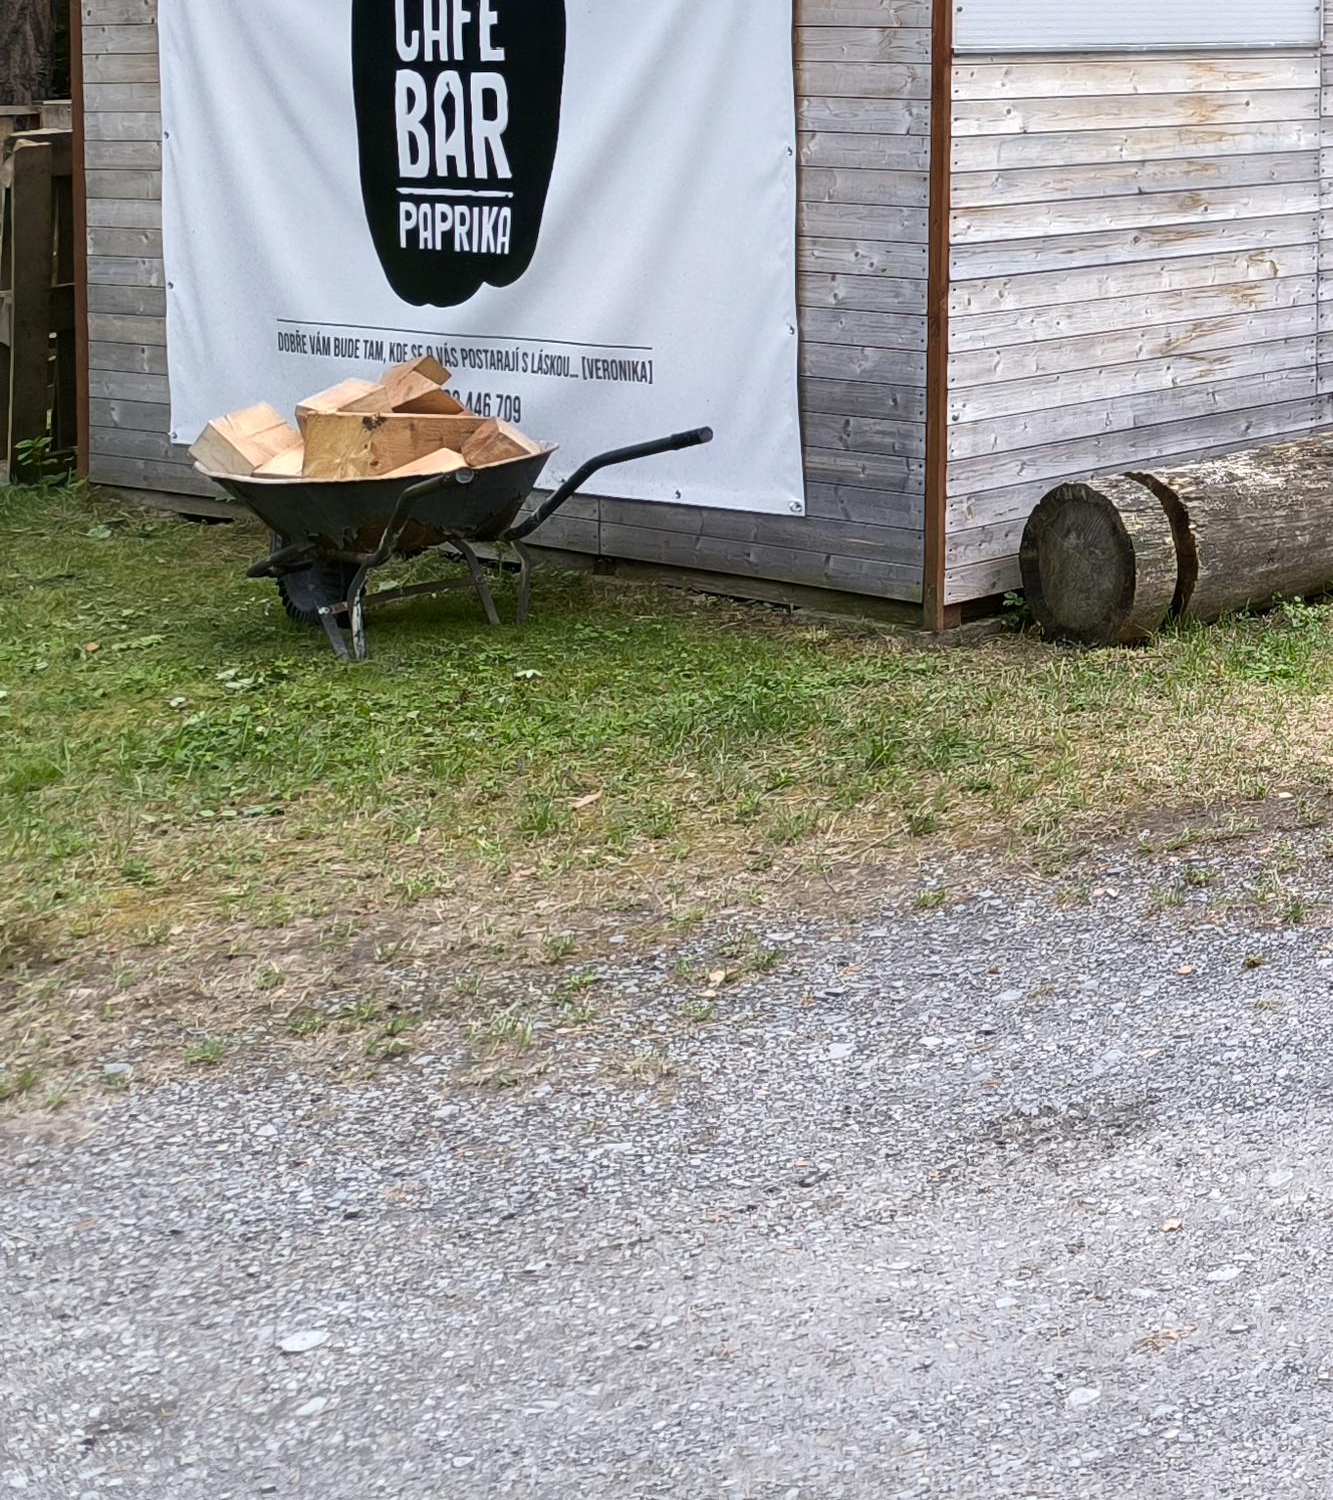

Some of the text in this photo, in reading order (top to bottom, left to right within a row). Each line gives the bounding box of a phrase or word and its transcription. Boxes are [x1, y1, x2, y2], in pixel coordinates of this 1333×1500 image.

[395, 68, 513, 179] BAR
[399, 201, 512, 255] PAPRIKA
[277, 330, 307, 354] DOBŘE
[309, 331, 331, 357] VÁM
[333, 337, 360, 359] BUDE
[363, 339, 387, 364] TAM,
[389, 341, 408, 363] KDE
[435, 342, 459, 368] VÁS
[461, 347, 520, 372] POSTARAJÍ
[521, 351, 529, 373] S
[581, 356, 653, 384] [VERONIKA]
[496, 394, 521, 423] 709
